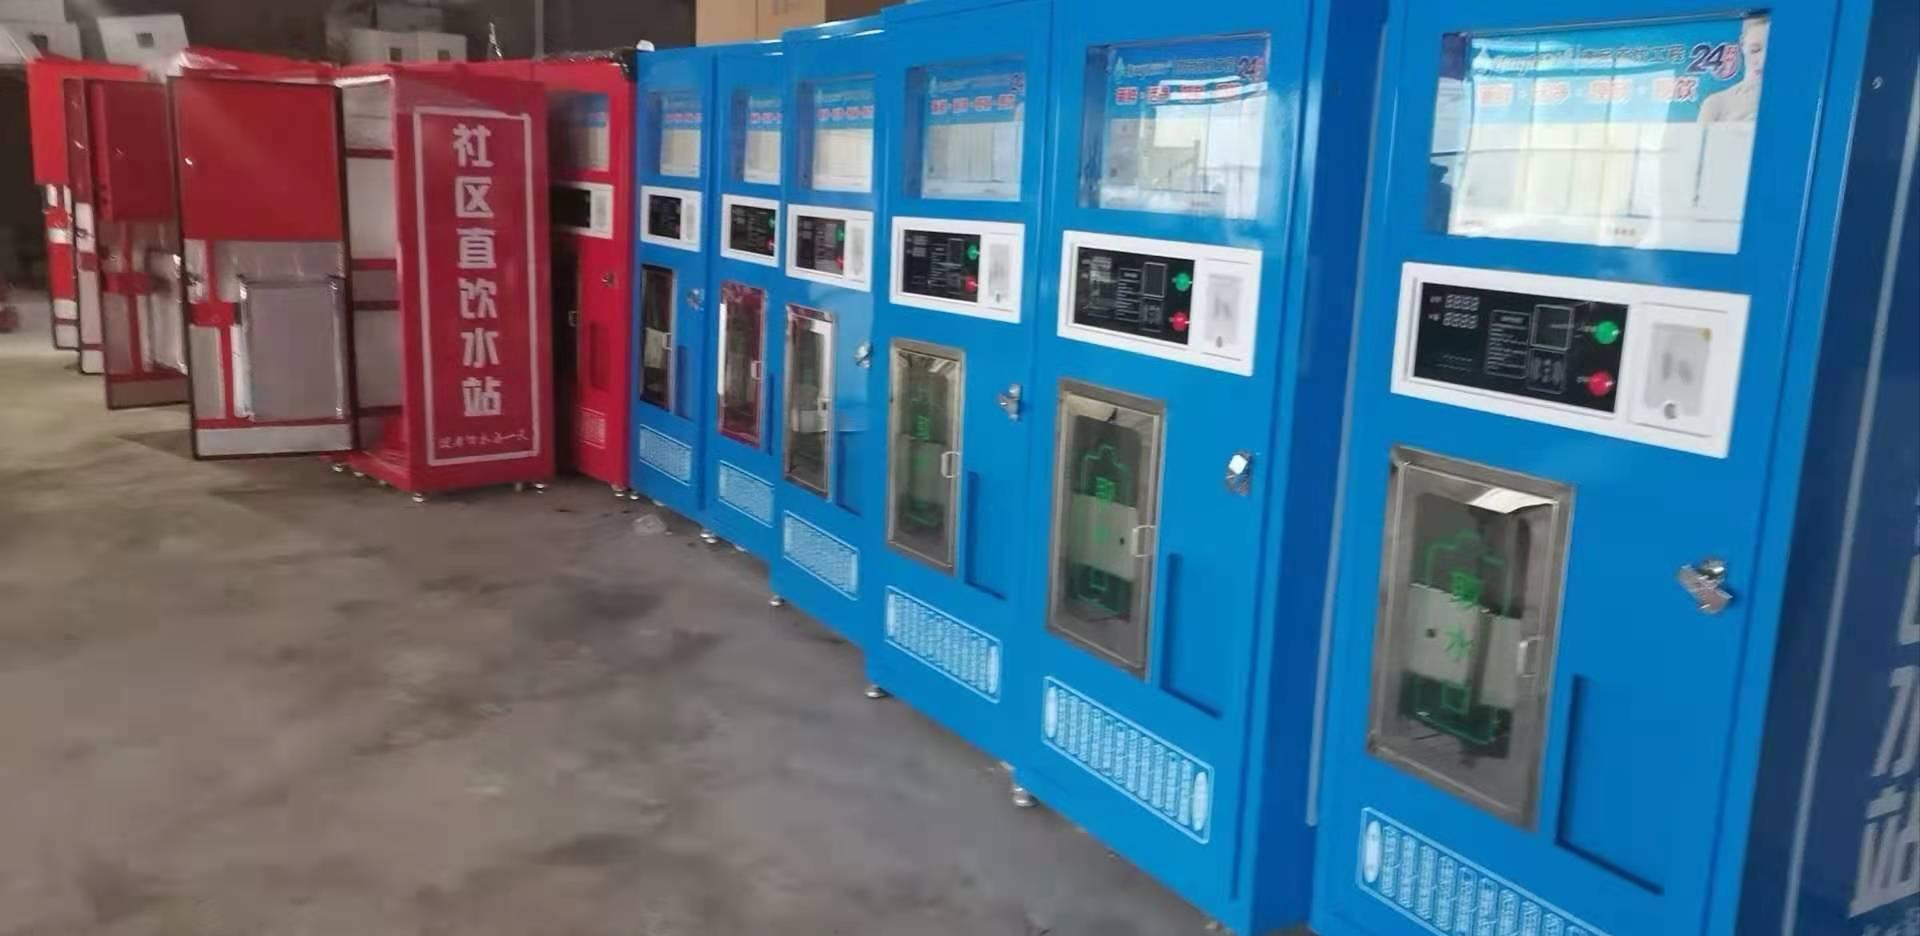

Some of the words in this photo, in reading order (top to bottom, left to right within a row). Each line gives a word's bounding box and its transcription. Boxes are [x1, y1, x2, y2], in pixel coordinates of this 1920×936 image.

[452, 123, 502, 417] 社区直饮水站
